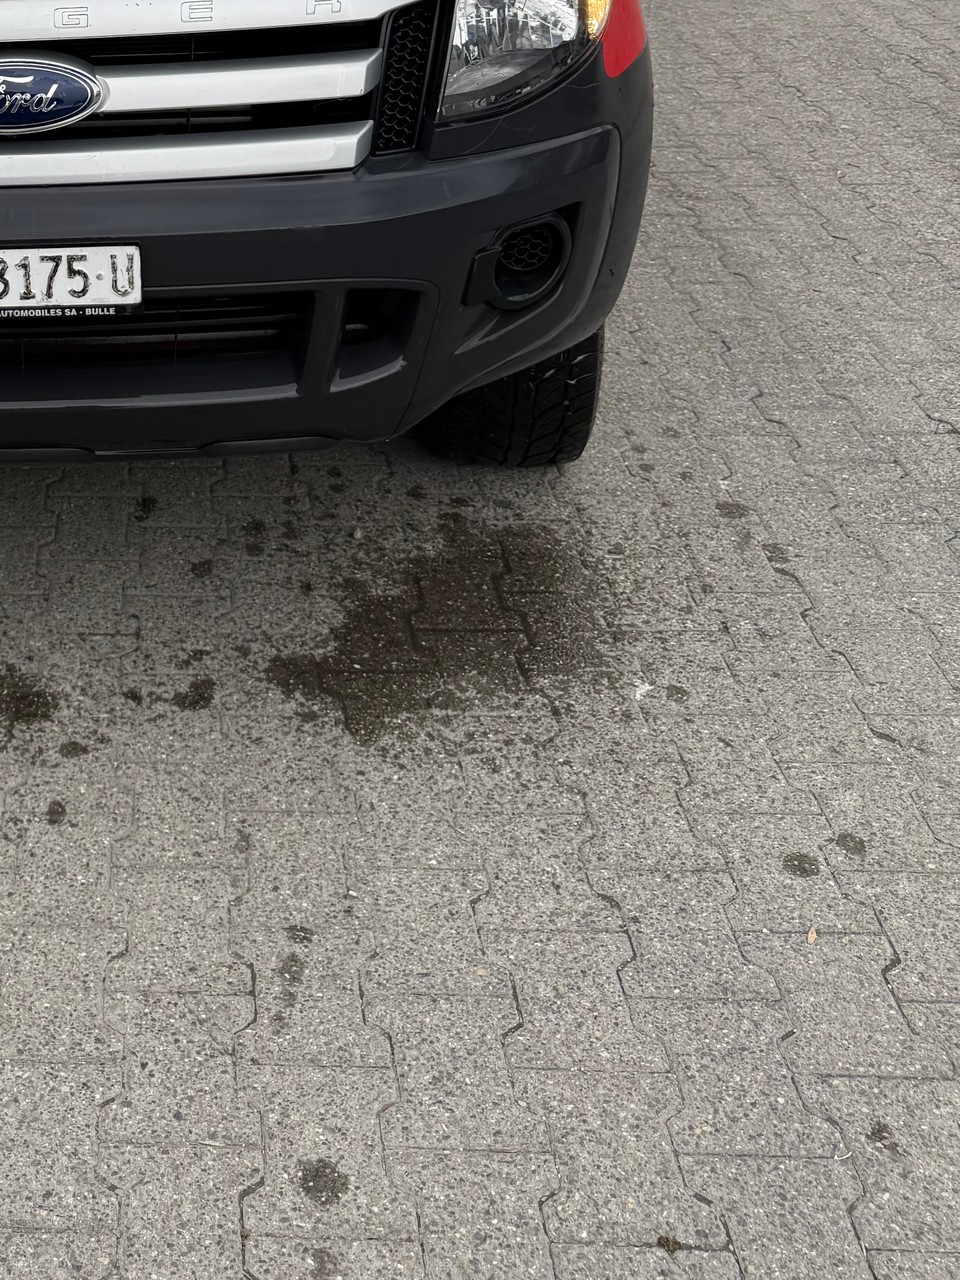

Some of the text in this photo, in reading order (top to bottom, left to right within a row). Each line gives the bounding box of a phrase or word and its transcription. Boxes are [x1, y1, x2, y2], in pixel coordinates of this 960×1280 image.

[108, 252, 136, 298] U
[64, 308, 78, 316] SA
[85, 307, 116, 316] BULLE
